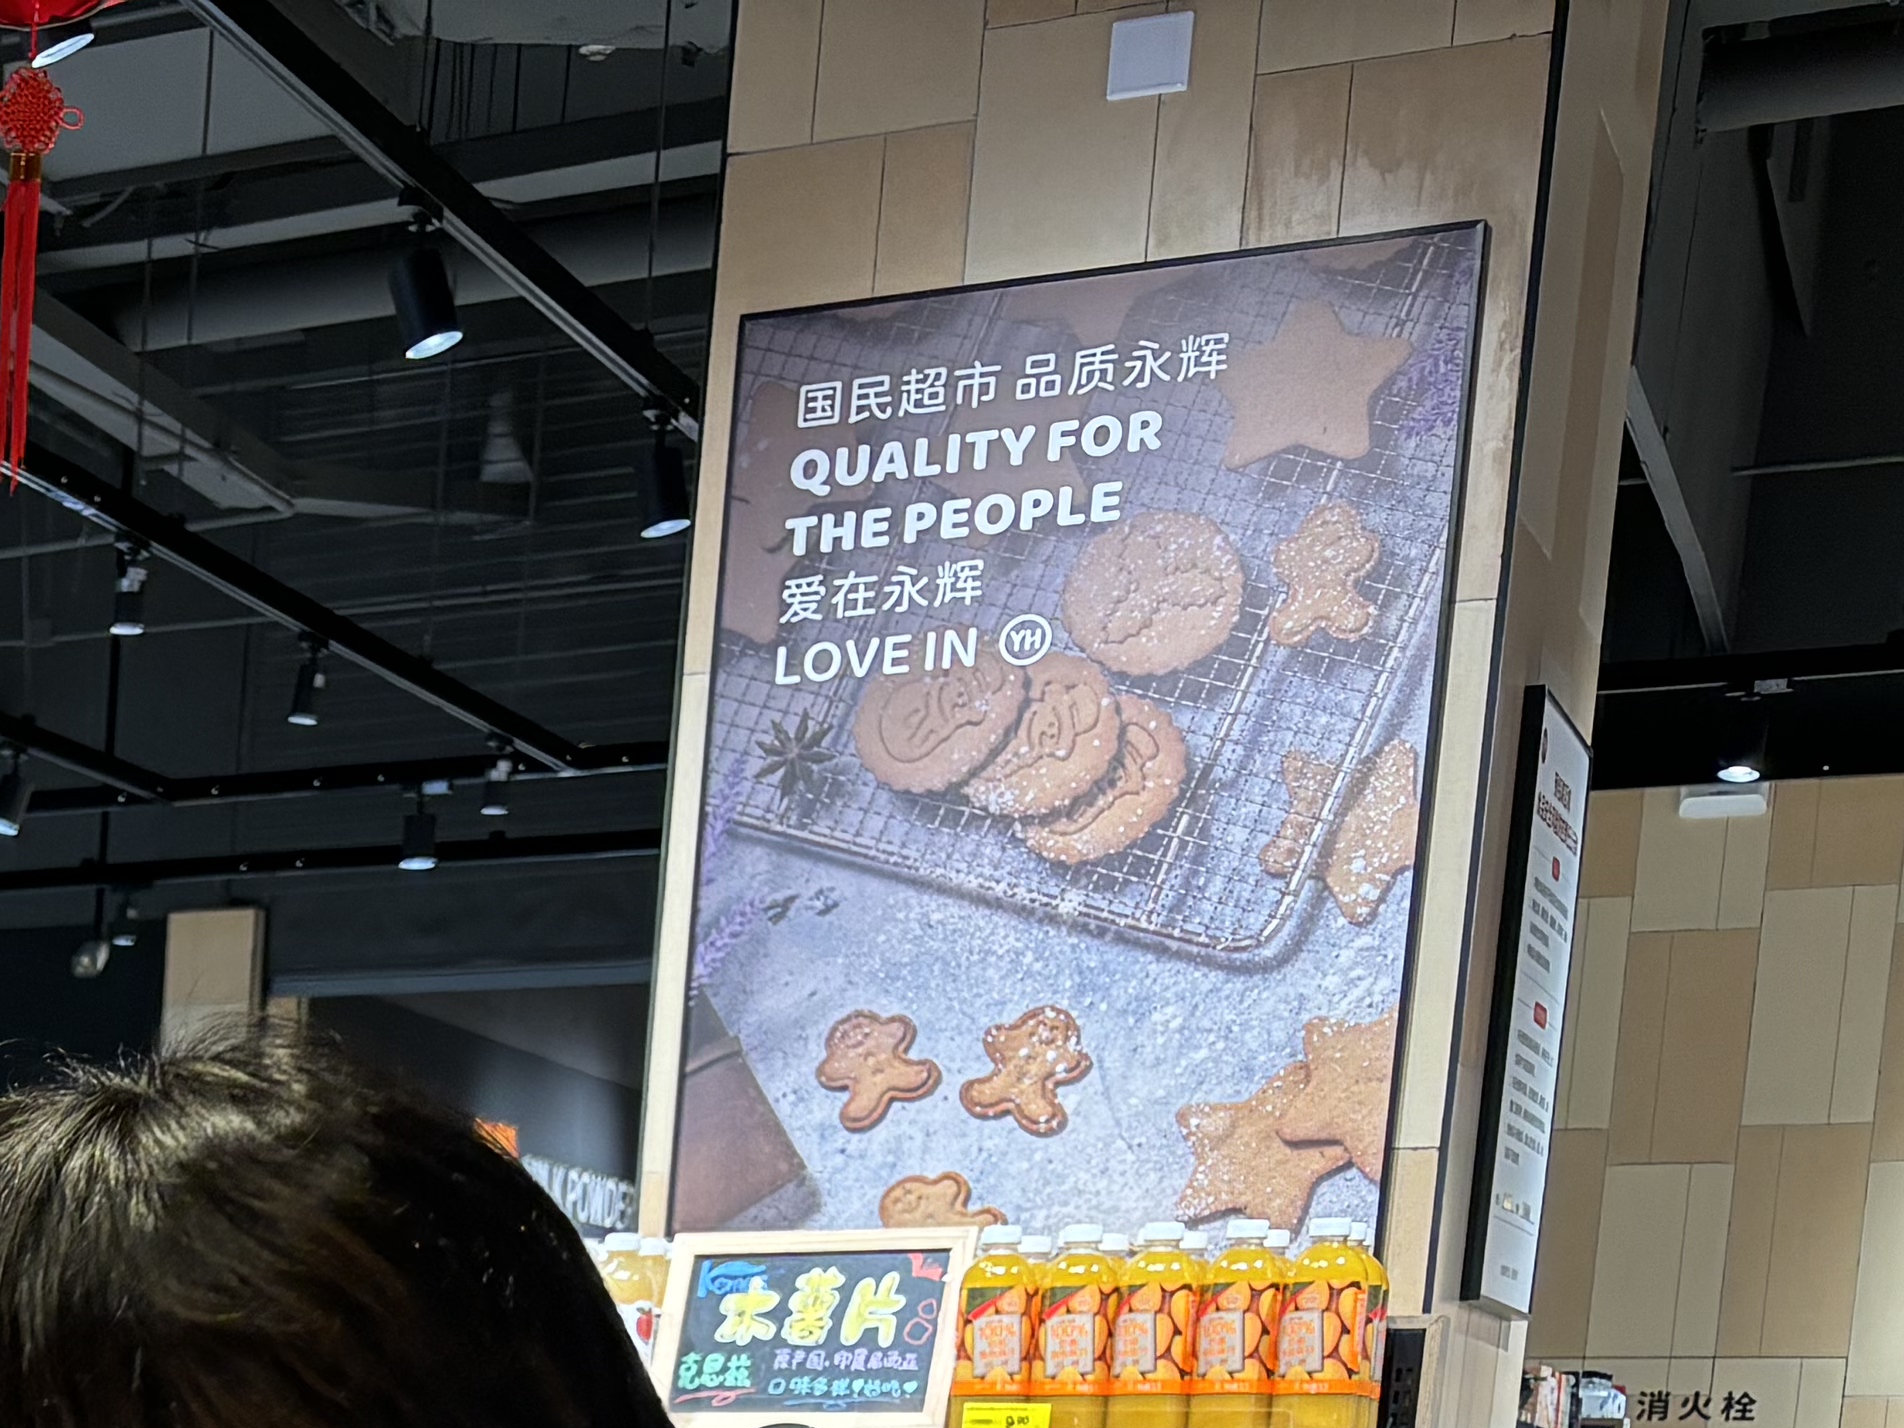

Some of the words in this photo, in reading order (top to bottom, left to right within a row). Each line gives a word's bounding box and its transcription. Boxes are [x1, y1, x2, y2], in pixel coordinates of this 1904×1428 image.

[797, 361, 1003, 428] 国民超市
[1016, 333, 1230, 403] 品质永辉
[790, 424, 1036, 495] QUALITY
[1048, 410, 1162, 467] FOR
[785, 507, 890, 556] THE
[903, 481, 1122, 543] PEOPLE
[779, 559, 985, 625] 爱在永辉
[774, 633, 912, 686] LOVE
[925, 626, 977, 670] IN
[714, 1266, 907, 1348] 木薯片
[1635, 1389, 1758, 1423] 消火栓
